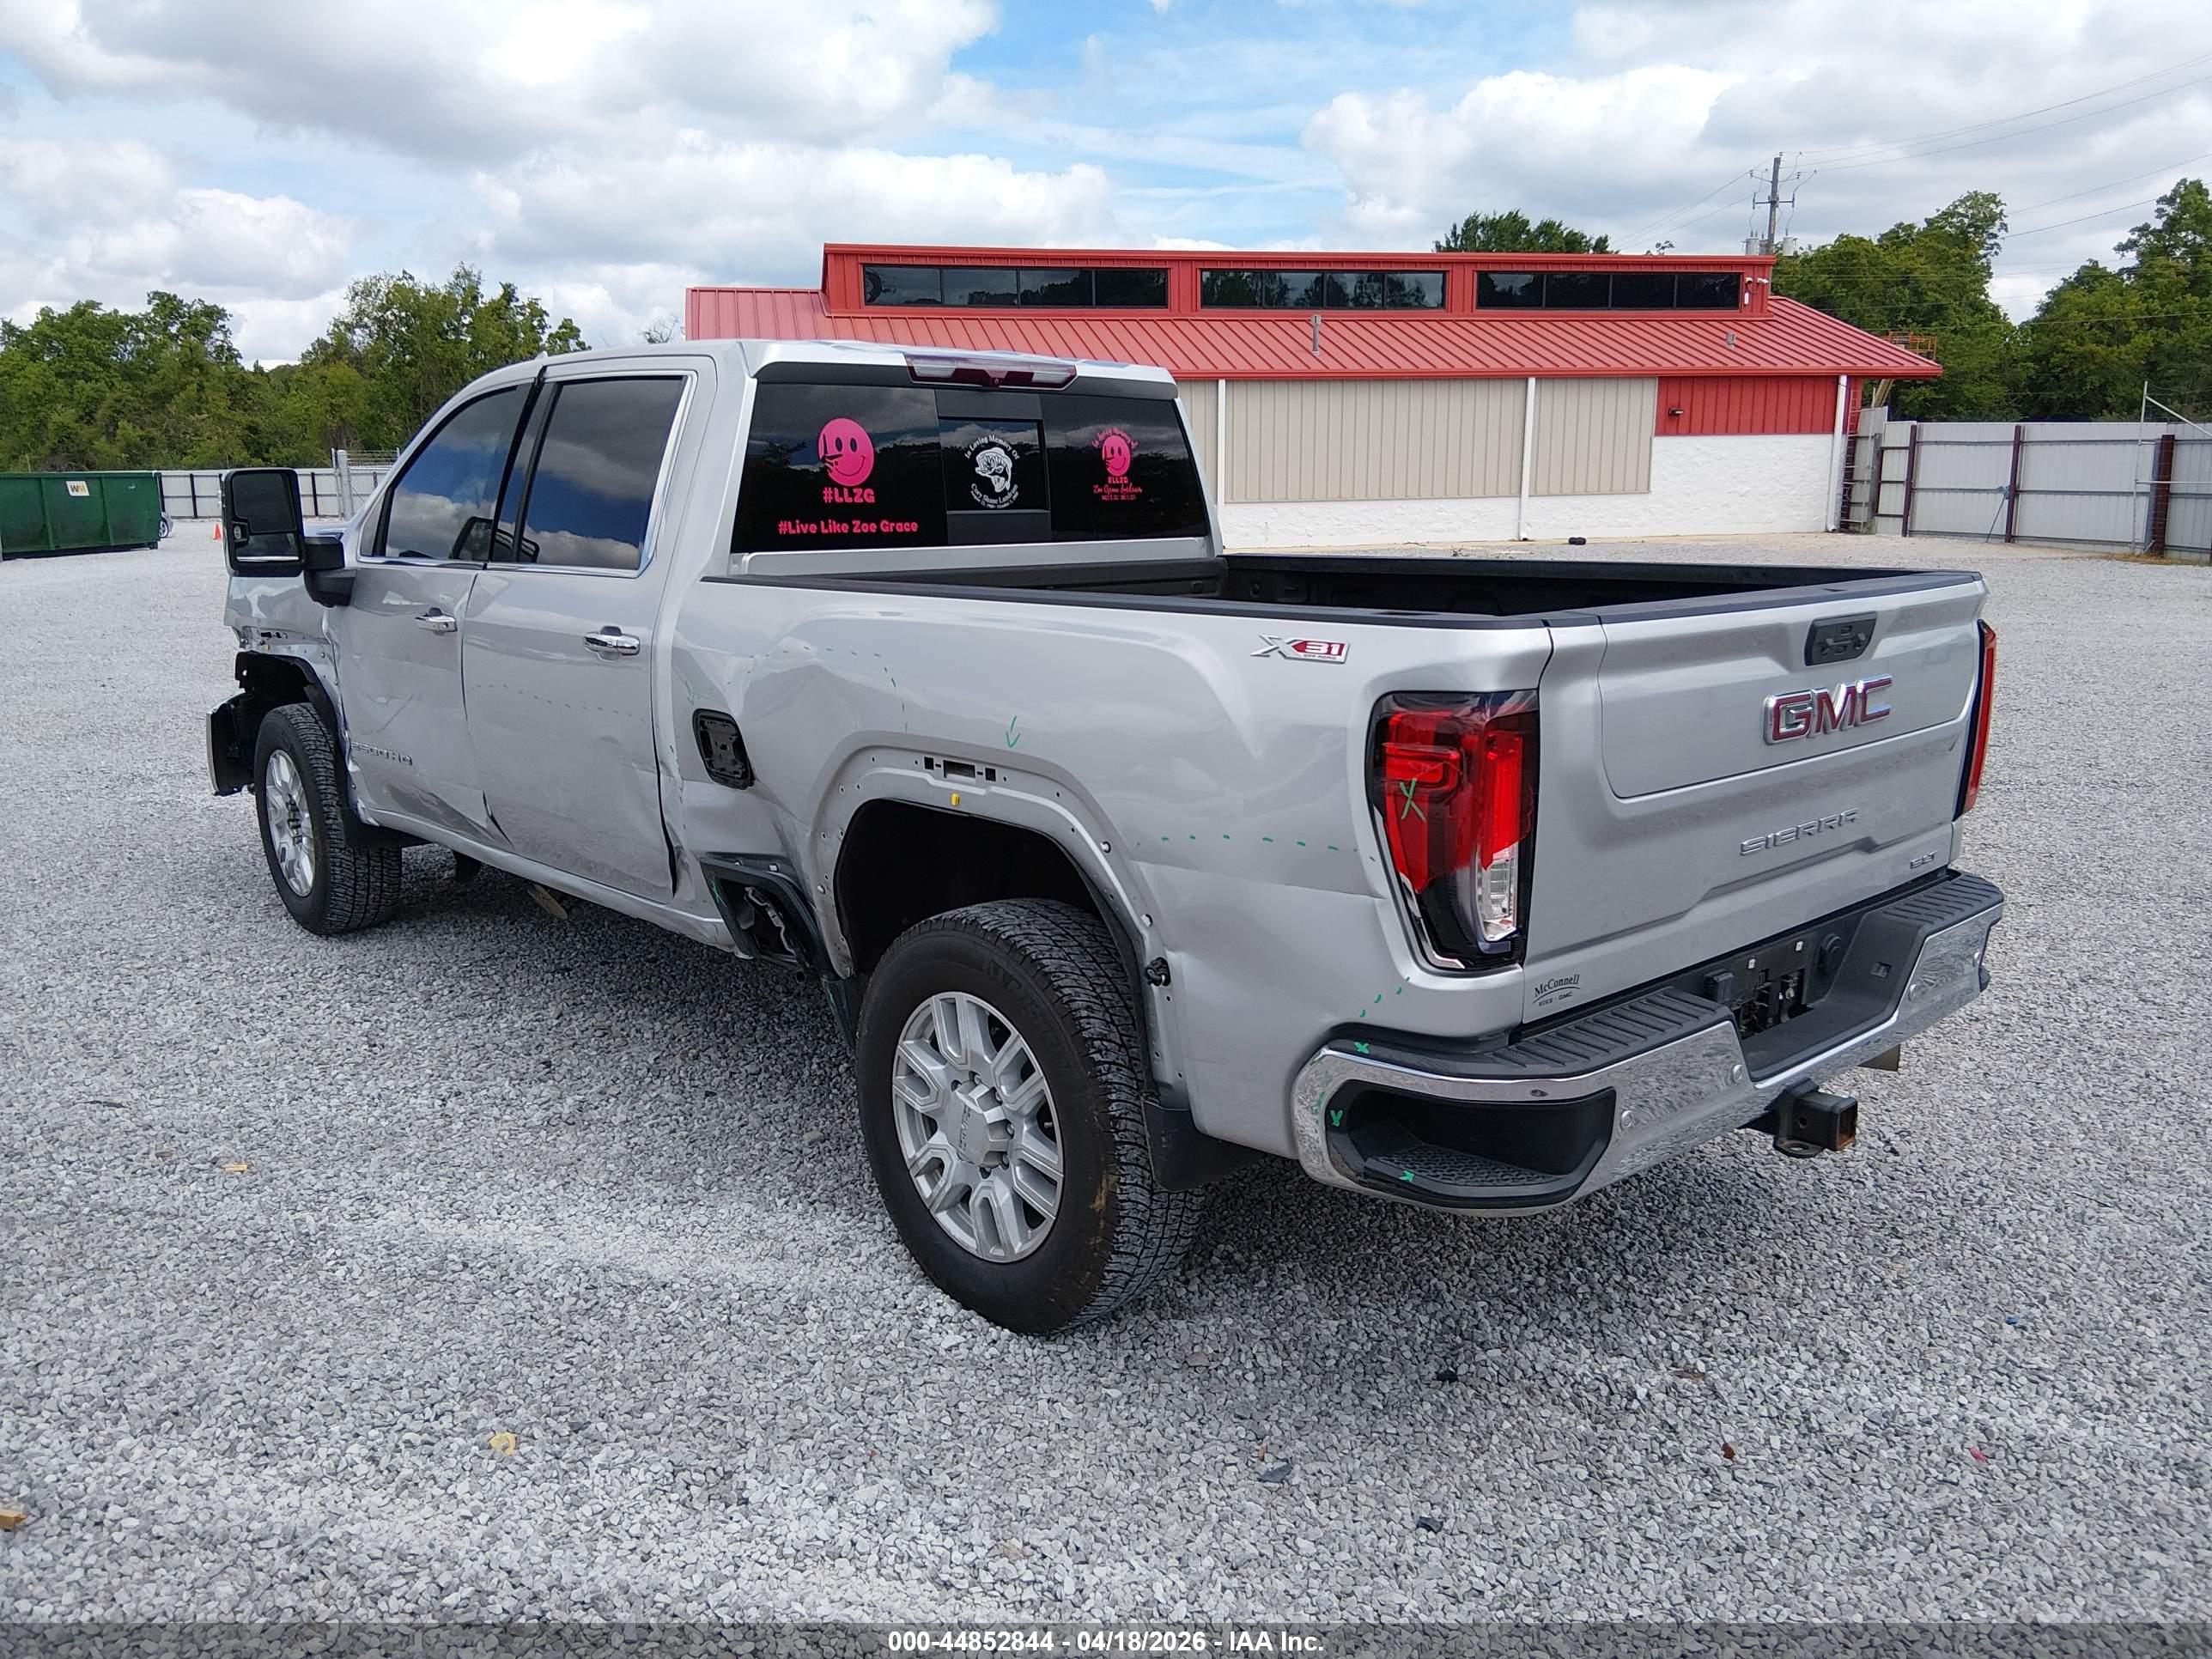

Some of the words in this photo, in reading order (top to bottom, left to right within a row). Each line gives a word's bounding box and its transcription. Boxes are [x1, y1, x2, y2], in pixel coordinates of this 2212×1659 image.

[964, 451, 972, 459] In
[969, 436, 988, 452] Loving
[988, 434, 1012, 452] Memory
[823, 486, 876, 503] #LLZG
[778, 519, 817, 535] #Live
[820, 519, 849, 534] Like
[852, 520, 878, 533] Zoe
[879, 520, 919, 533] Grace
[1763, 673, 1893, 745] GMC
[1740, 807, 1860, 856] SIERRA
[1534, 974, 1580, 997] McConnell
